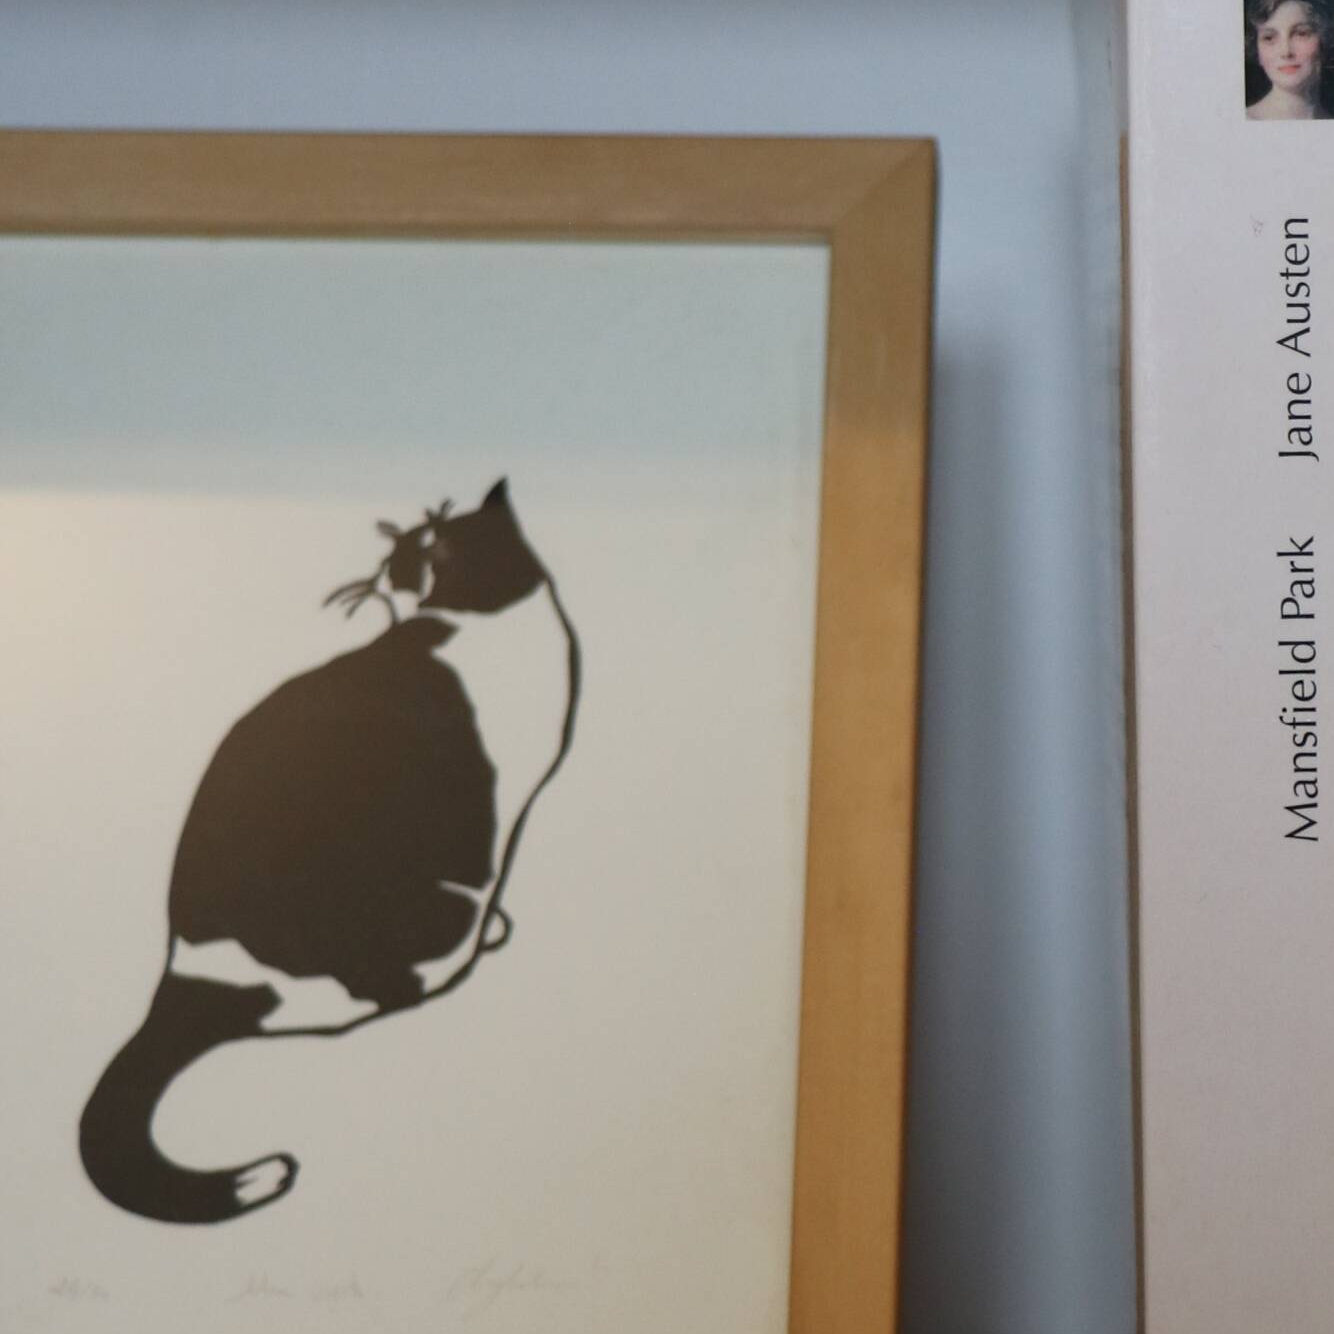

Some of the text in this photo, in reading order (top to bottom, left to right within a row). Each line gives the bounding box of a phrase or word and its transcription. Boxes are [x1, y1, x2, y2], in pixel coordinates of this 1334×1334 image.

[1275, 217, 1320, 842] Mansfield Park Jane Austen
